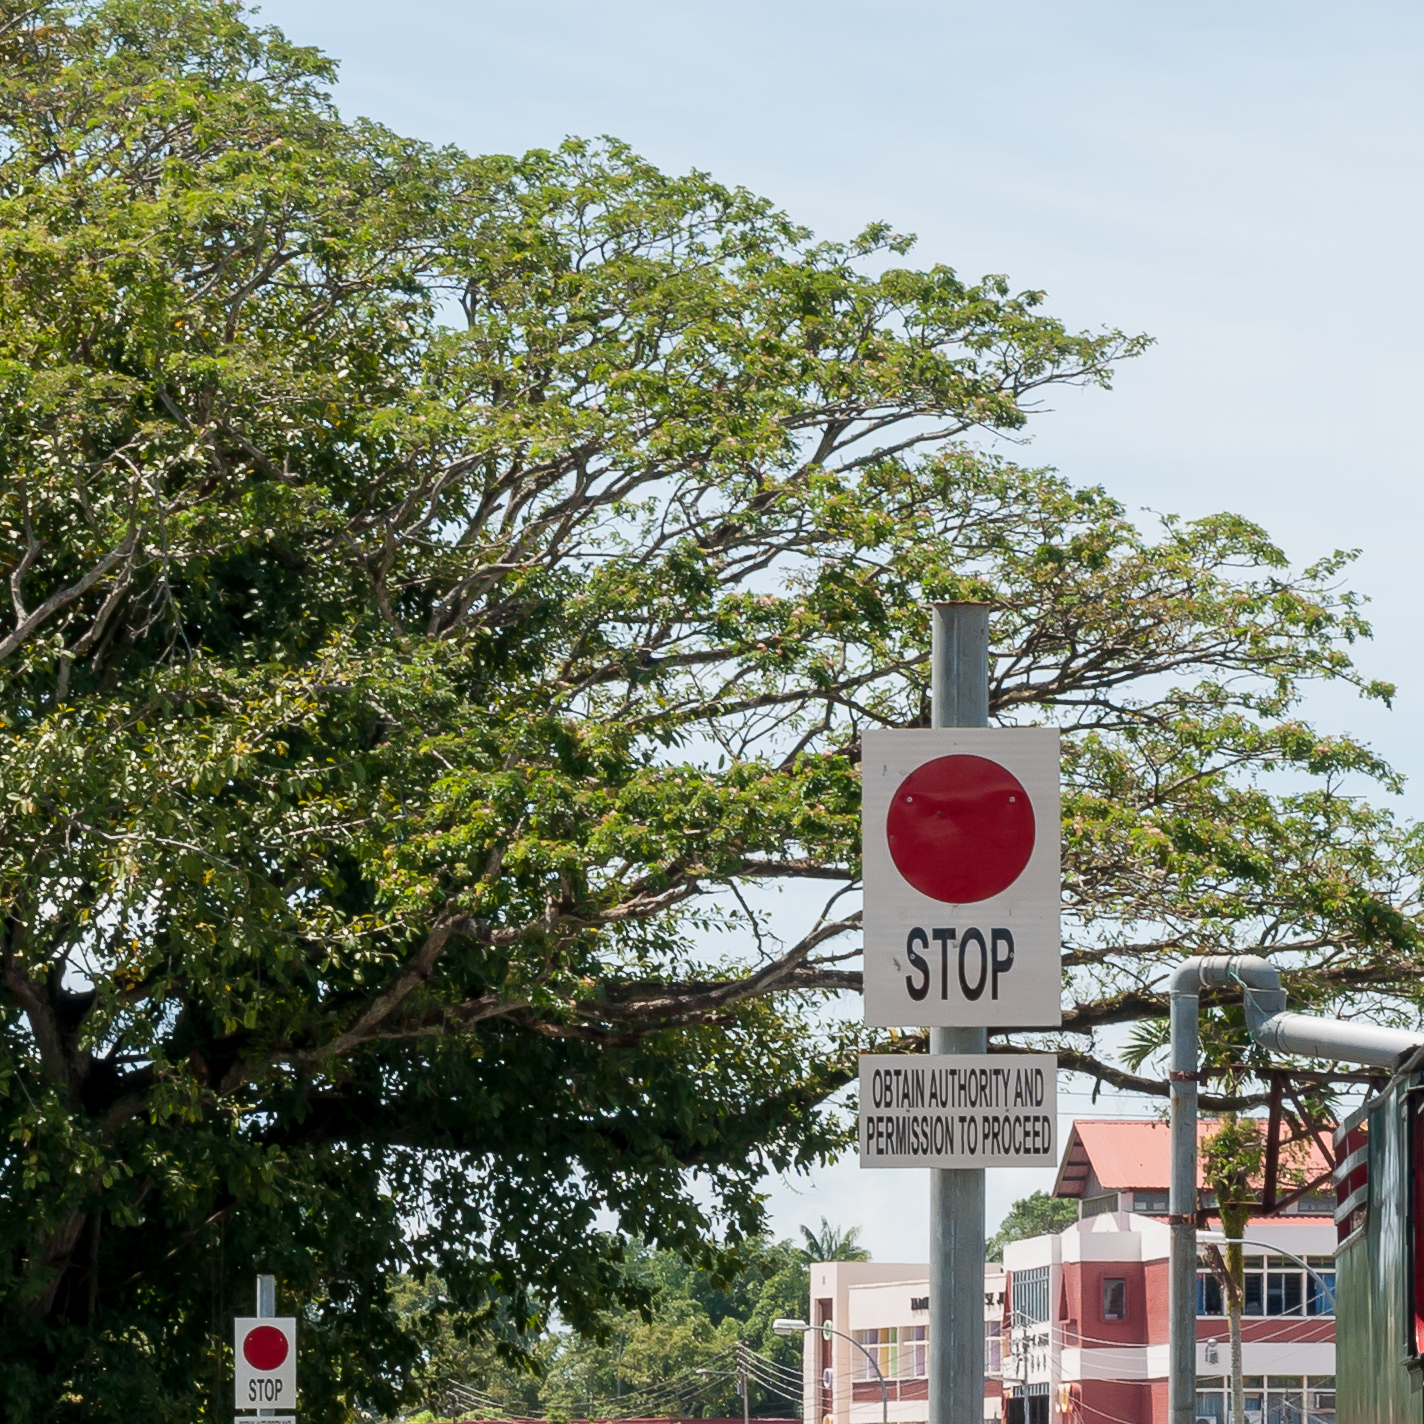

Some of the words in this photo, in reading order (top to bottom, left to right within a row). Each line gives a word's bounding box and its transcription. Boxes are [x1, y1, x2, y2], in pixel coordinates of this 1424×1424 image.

[906, 926, 1014, 1001] STOP
[873, 1068, 924, 1108] OBTAIN
[929, 1068, 1010, 1108] AUTHORITY
[1014, 1068, 1044, 1107] AND
[866, 1115, 954, 1155] PERMISSION
[958, 1115, 977, 1155] TO
[982, 1114, 1051, 1155] PROCEED
[248, 1378, 282, 1401] STOP
